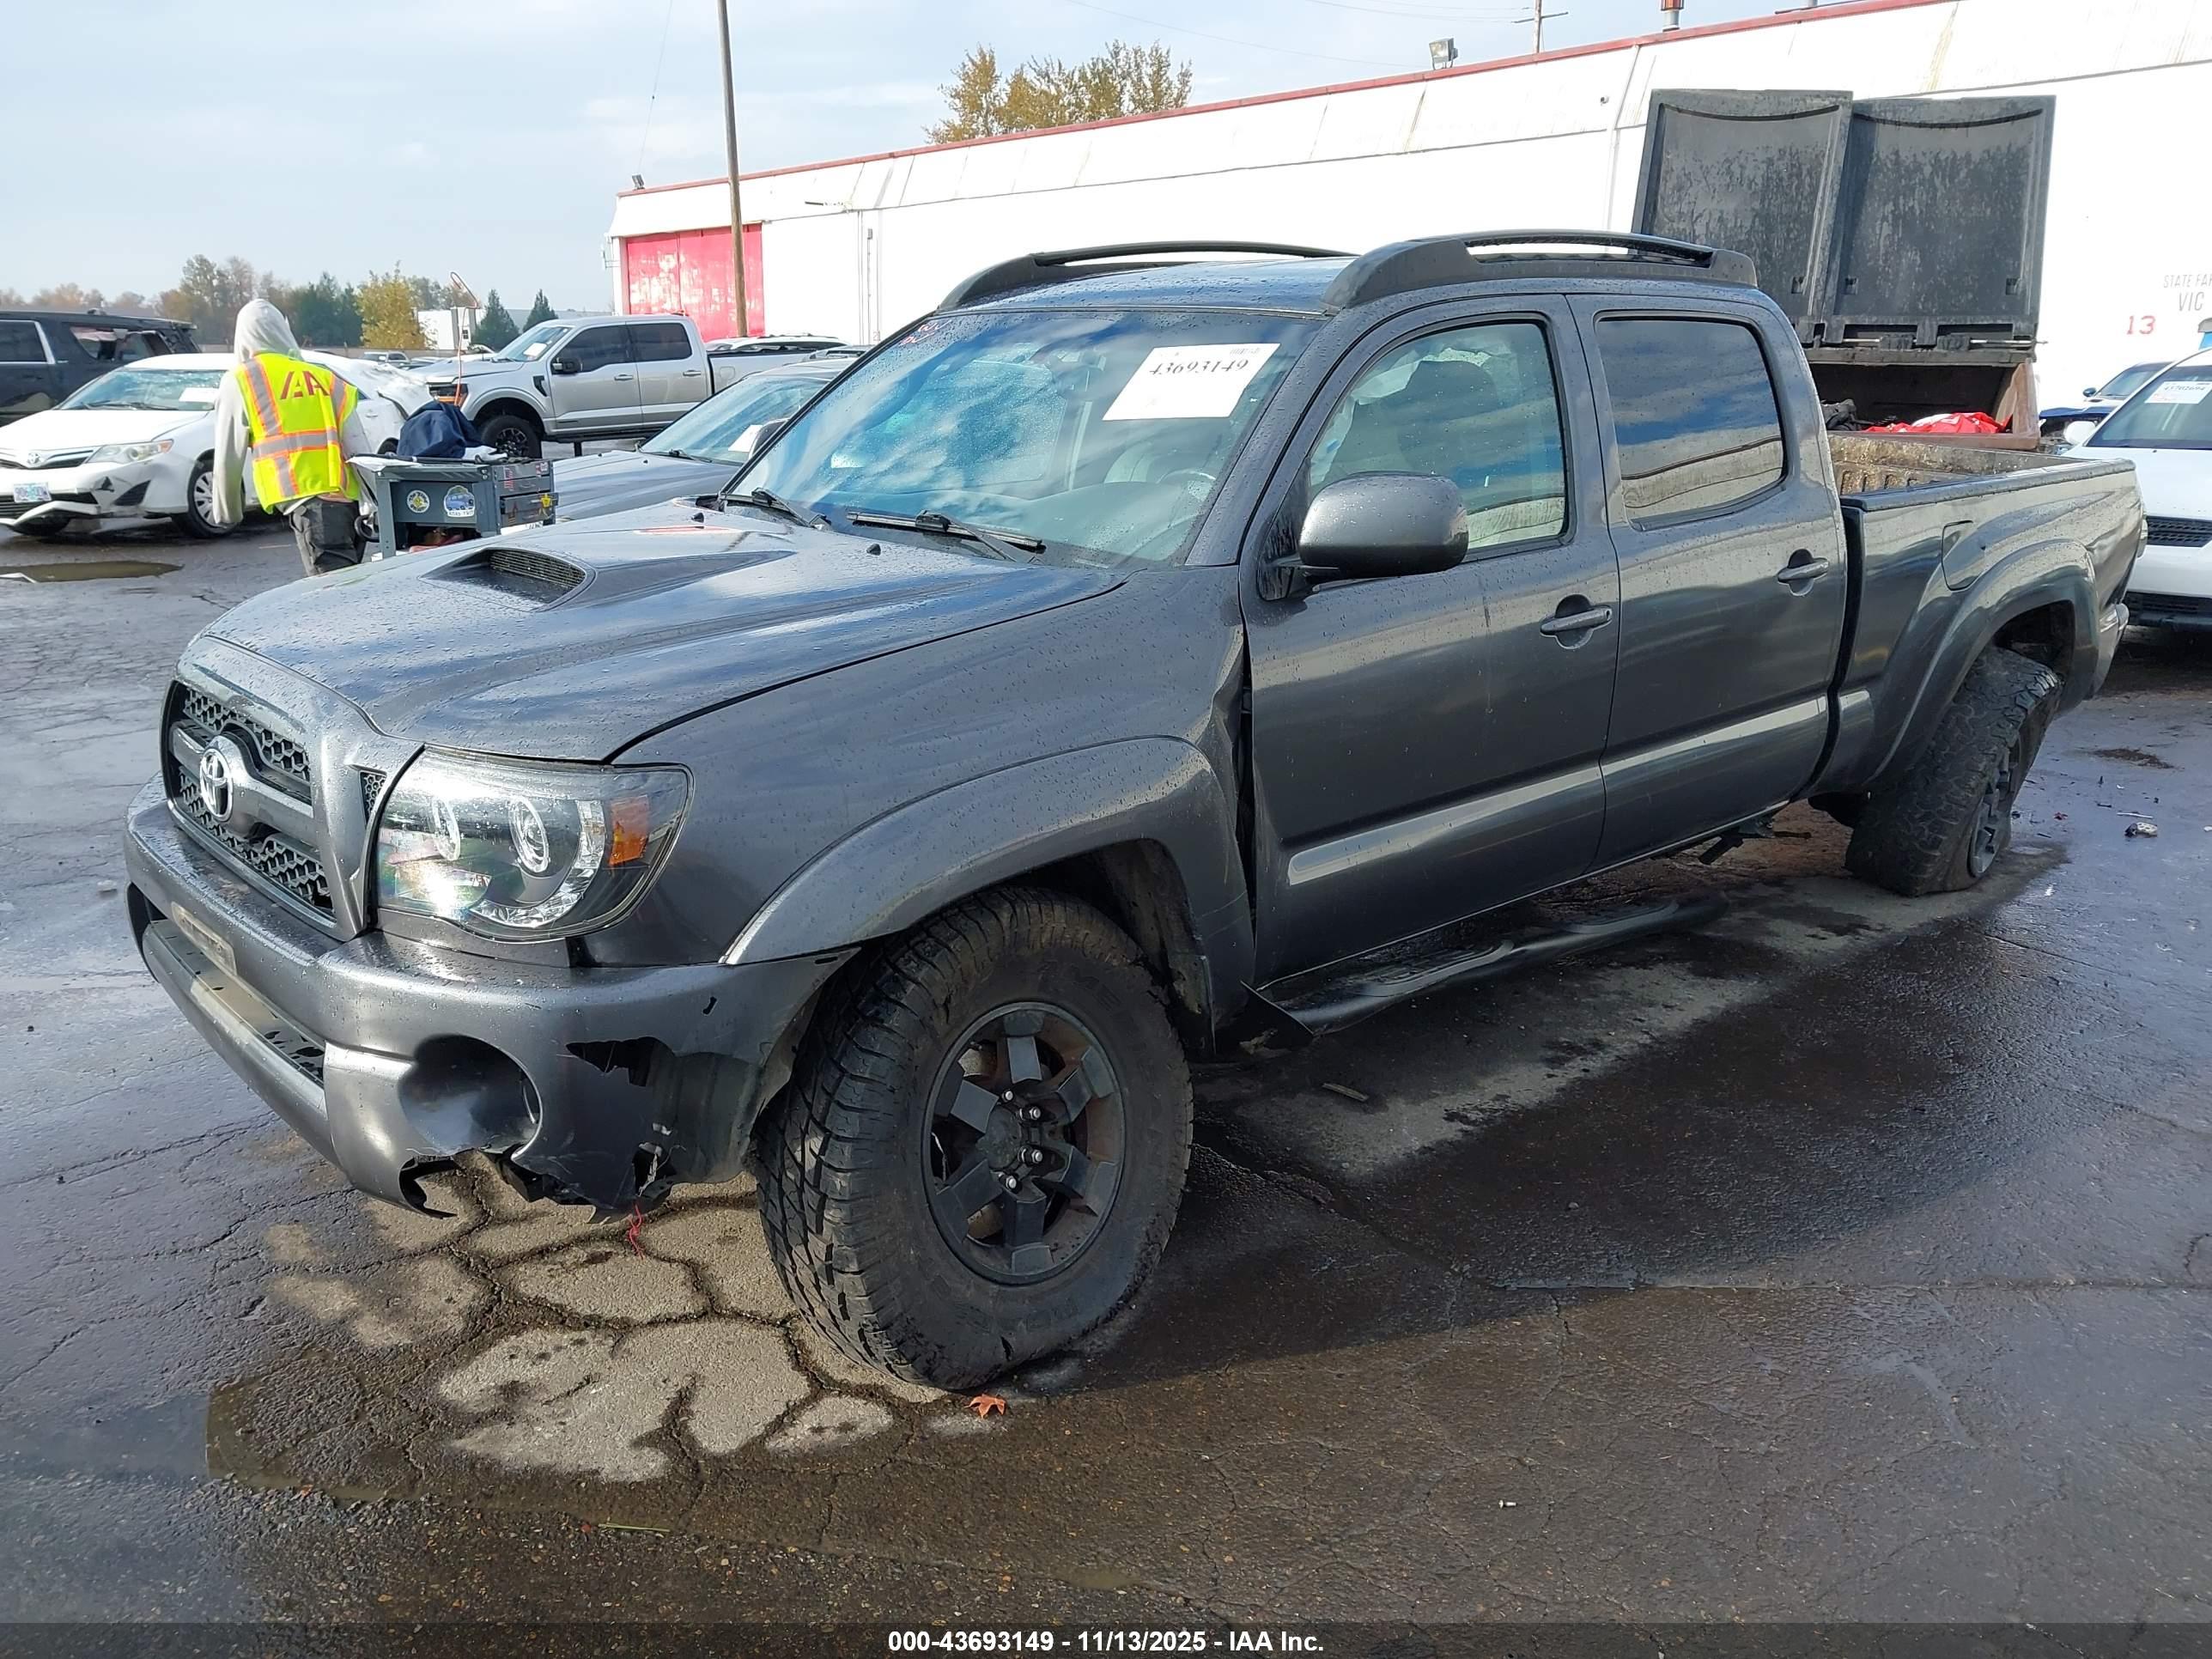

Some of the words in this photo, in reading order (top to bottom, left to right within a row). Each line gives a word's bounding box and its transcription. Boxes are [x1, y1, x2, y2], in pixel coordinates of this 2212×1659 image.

[2163, 274, 2192, 289] STATE
[2179, 291, 2205, 312] VIC
[2126, 315, 2156, 335] 13
[1149, 358, 1249, 375] 43693149
